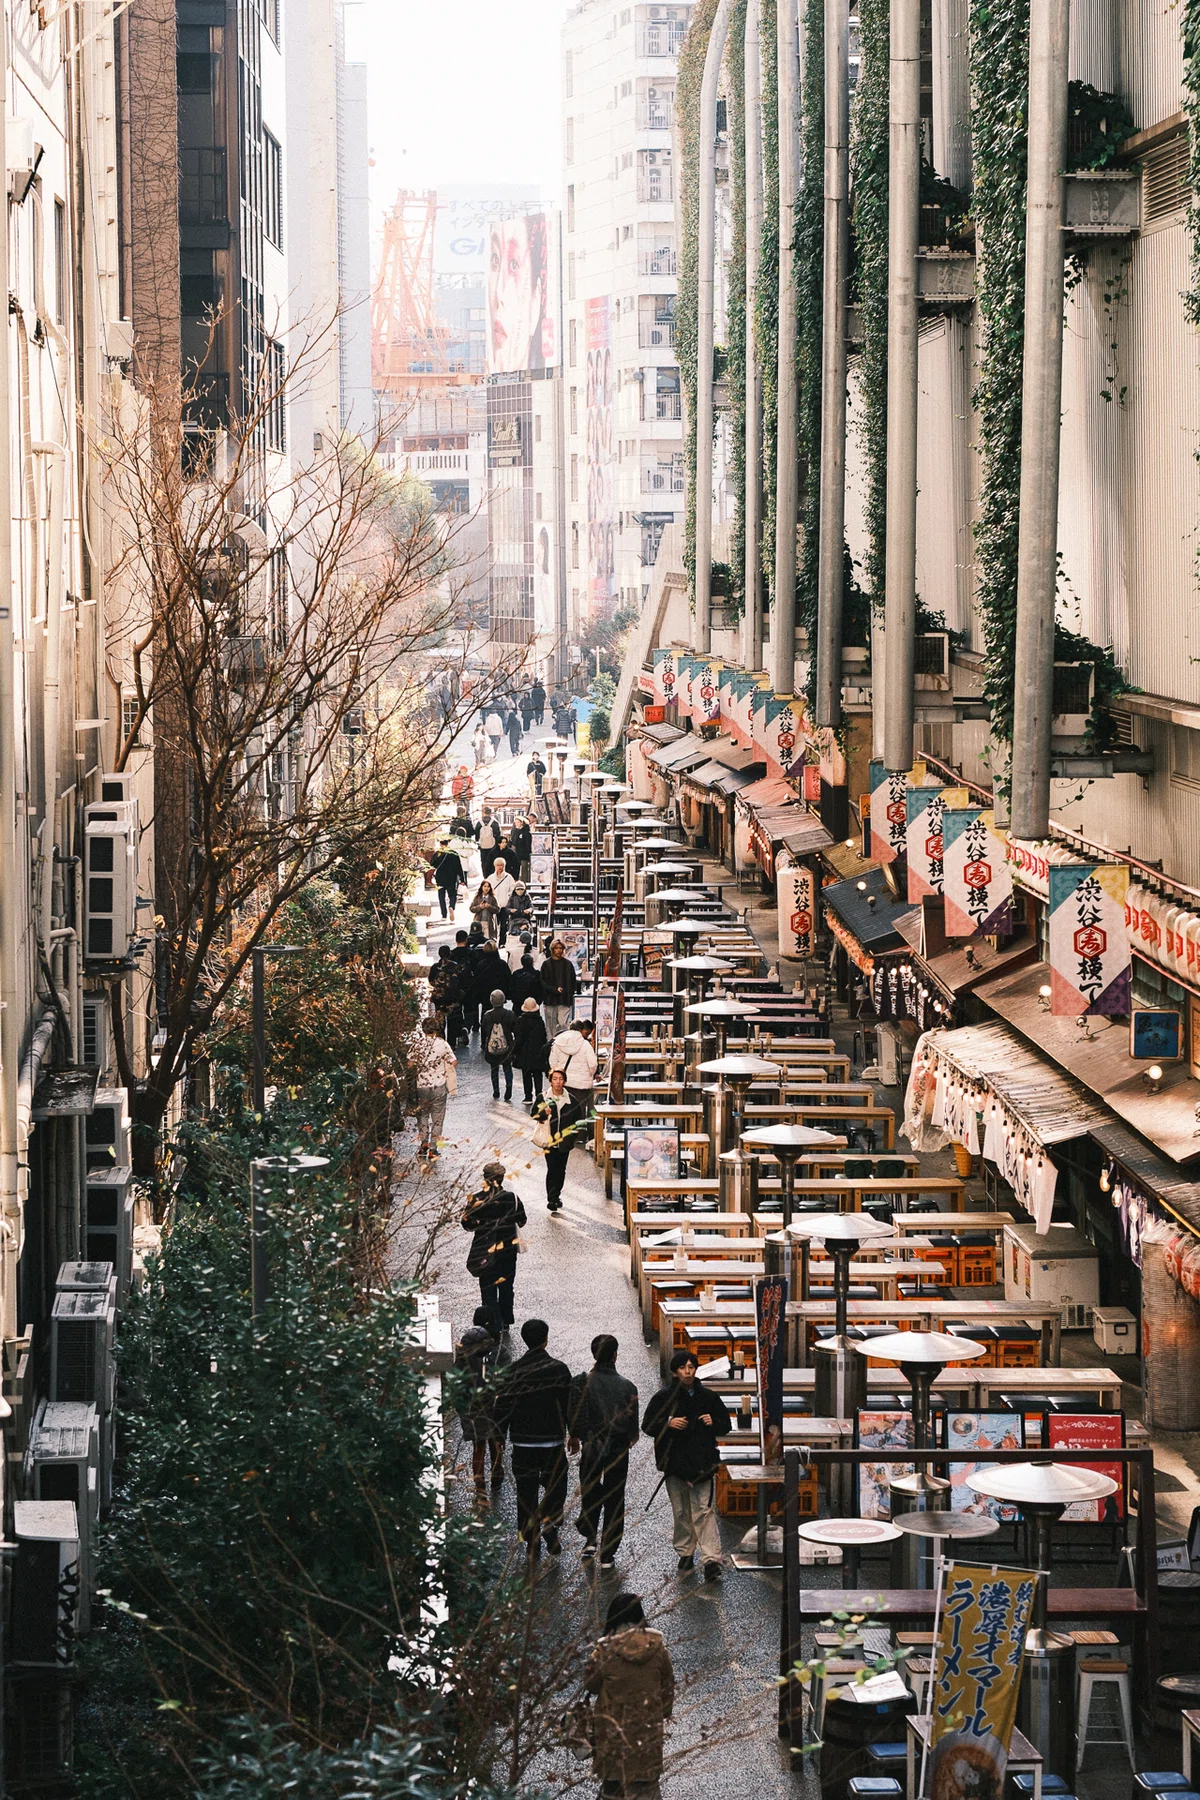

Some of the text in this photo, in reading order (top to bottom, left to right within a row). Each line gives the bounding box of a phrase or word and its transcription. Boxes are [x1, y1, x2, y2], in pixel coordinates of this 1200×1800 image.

[938, 1579, 974, 1717] ラーメン
[958, 1581, 1013, 1738] 濃厚オマール
